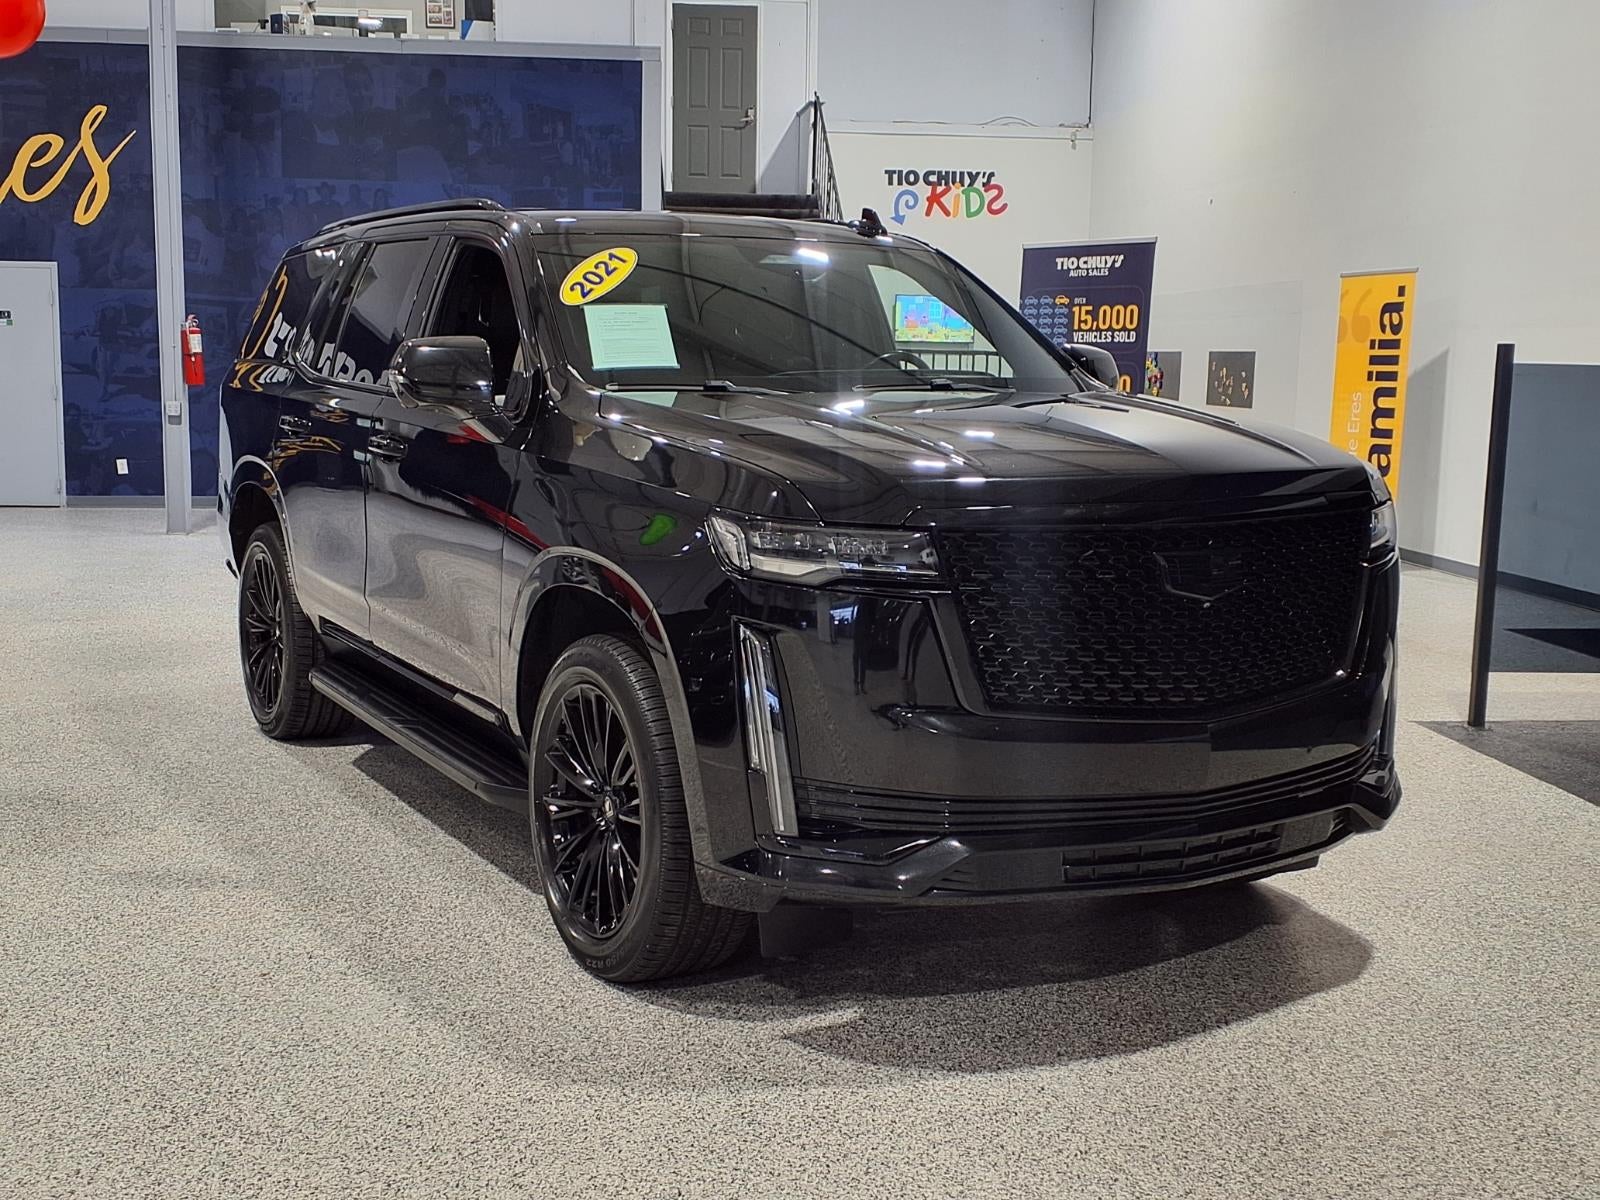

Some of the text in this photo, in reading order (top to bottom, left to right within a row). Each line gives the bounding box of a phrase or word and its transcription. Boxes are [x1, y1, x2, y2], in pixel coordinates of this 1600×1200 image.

[0, 104, 137, 226] es
[884, 169, 920, 186] TIO
[569, 252, 627, 299] 2021
[1055, 254, 1124, 270] TIO CHUY'S
[1069, 268, 1109, 277] AUTO SALES
[1072, 304, 1139, 331] 15,000
[1073, 331, 1136, 343] VEHICLES SOLD
[1367, 284, 1407, 479] amilia.
[1347, 391, 1362, 433] Eres
